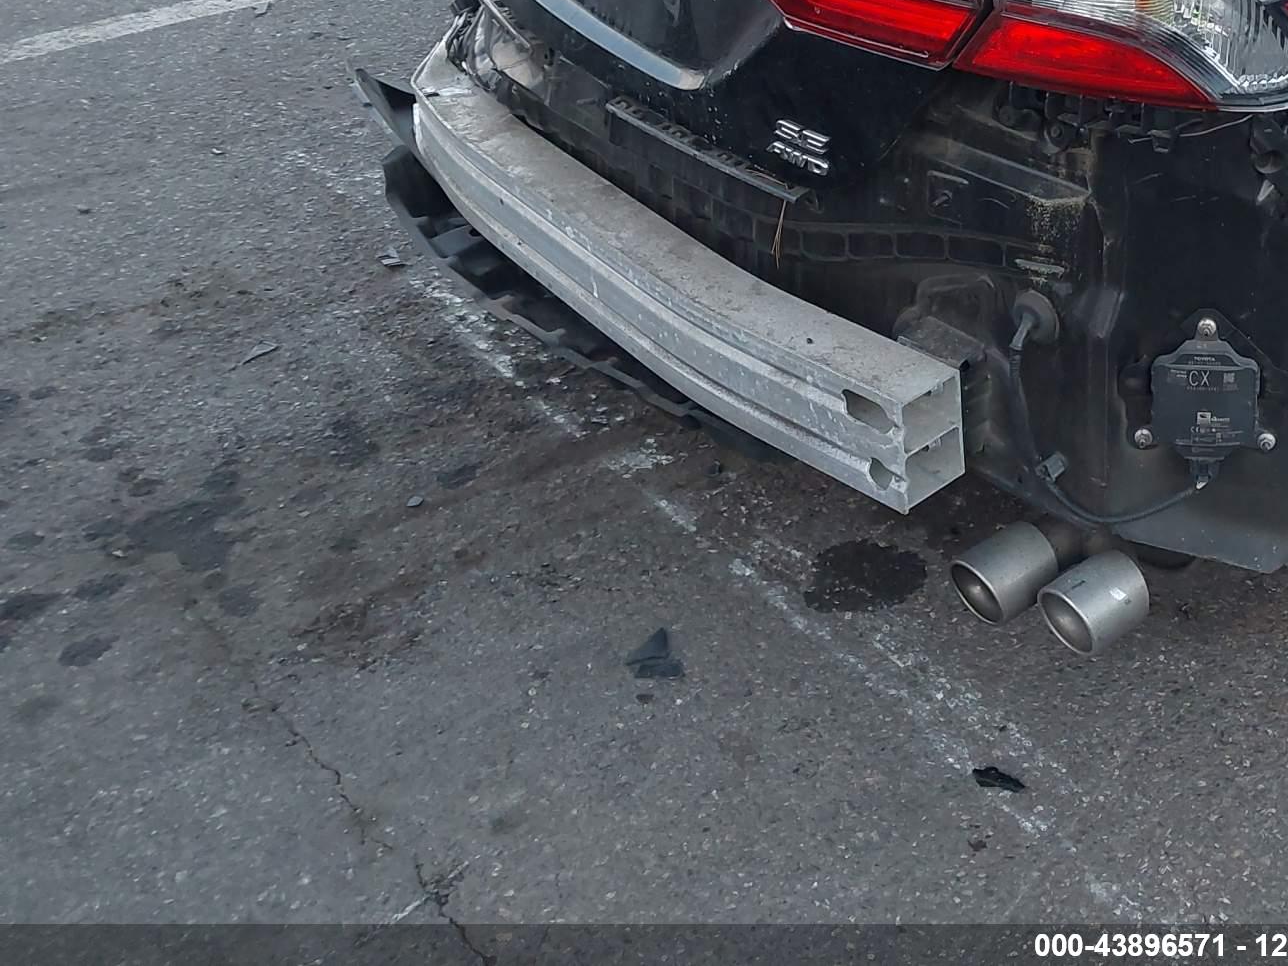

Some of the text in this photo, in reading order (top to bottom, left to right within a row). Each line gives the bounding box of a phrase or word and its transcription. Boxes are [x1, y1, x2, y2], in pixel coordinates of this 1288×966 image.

[774, 120, 831, 155] SE
[766, 141, 829, 176] AWD
[1189, 370, 1210, 387] CX
